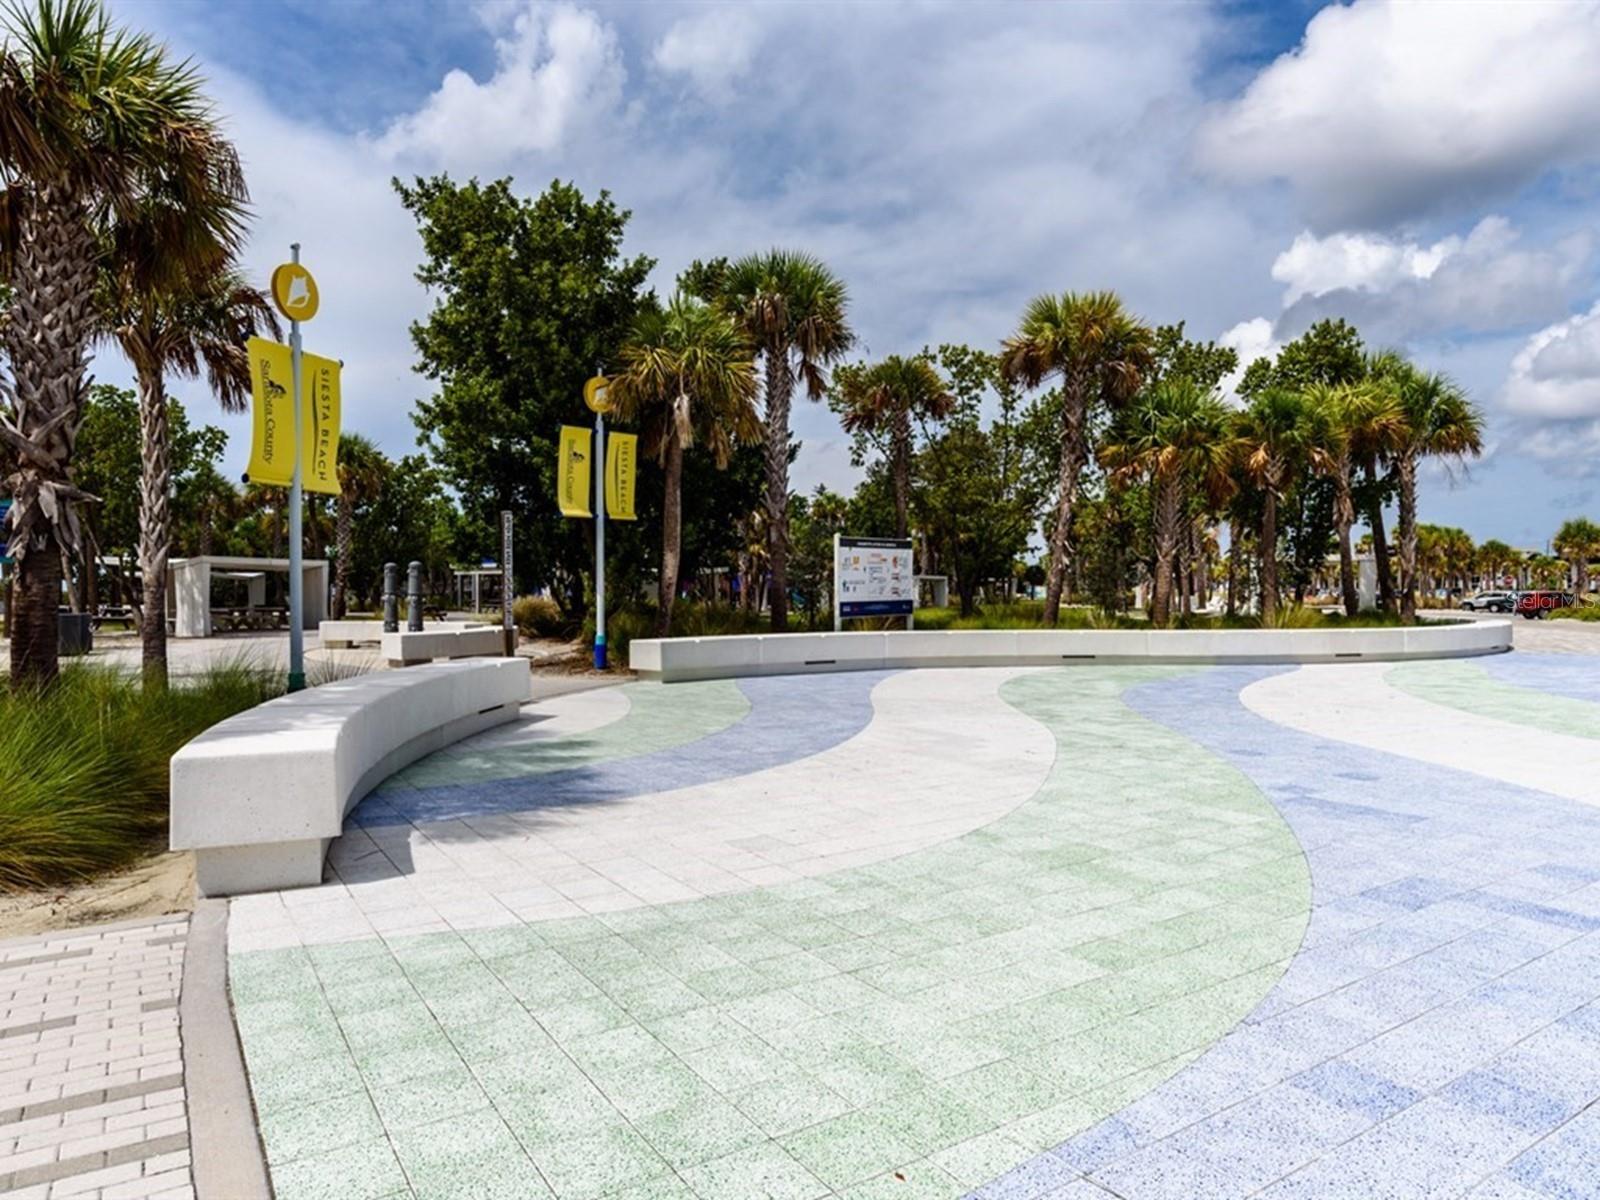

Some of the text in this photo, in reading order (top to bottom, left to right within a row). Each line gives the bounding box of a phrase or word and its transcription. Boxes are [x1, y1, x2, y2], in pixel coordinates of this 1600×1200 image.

[262, 418, 276, 465] County
[318, 367, 331, 482] SIESTA BEACH
